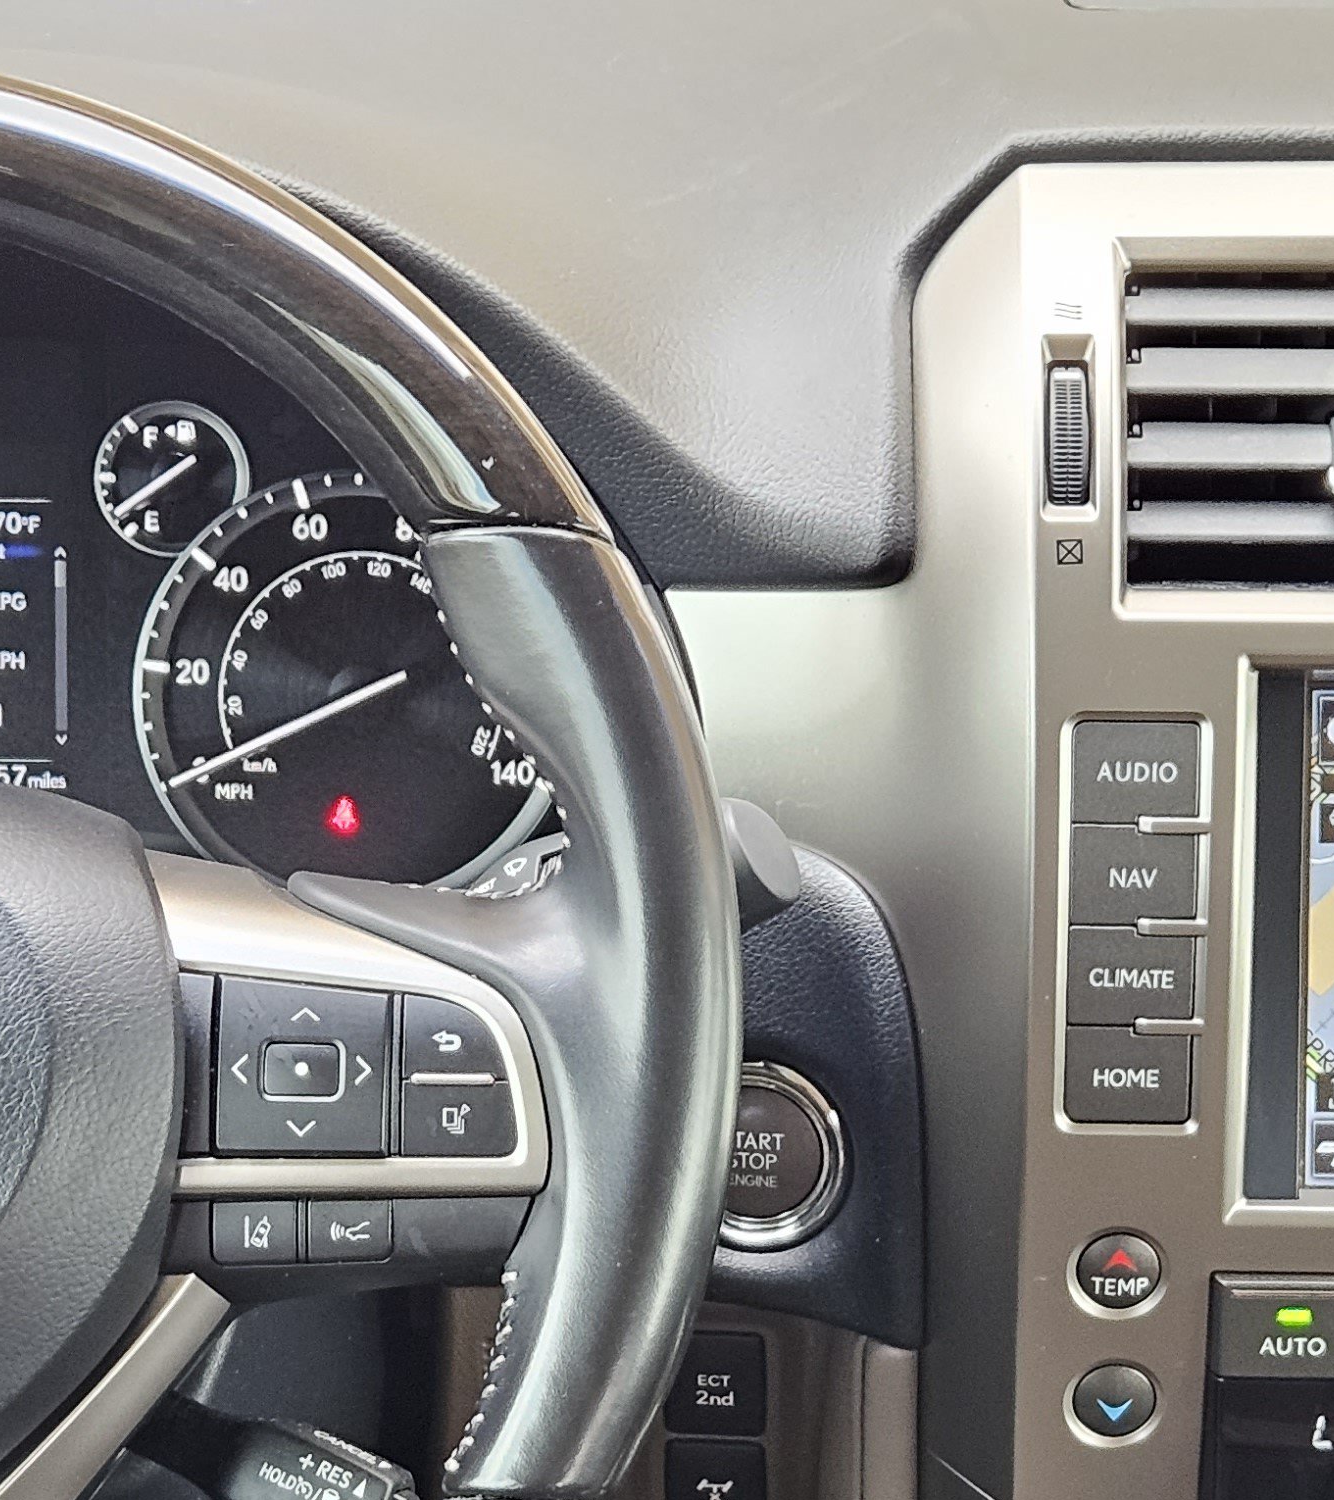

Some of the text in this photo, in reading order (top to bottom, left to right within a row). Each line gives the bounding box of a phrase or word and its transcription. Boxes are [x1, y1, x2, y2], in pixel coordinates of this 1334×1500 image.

[142, 427, 160, 449] F
[144, 513, 161, 533] E
[291, 514, 329, 542] 60
[212, 566, 250, 594] 40
[320, 561, 347, 580] 100
[366, 560, 392, 579] 120
[281, 578, 303, 599] 80
[250, 608, 269, 631] 60
[175, 658, 210, 686] 20
[231, 649, 249, 673] 40
[227, 694, 244, 717] 20
[490, 759, 537, 787] 140
[1096, 762, 1179, 784] AUDIO
[214, 782, 254, 801] MPH
[1108, 867, 1159, 889] NAV
[1089, 968, 1175, 990] CLIMATE
[1093, 1067, 1160, 1089] HOME
[1091, 1276, 1151, 1297] TEMP
[1259, 1336, 1327, 1357] AUTO
[697, 1374, 731, 1388] ECT
[696, 1390, 735, 1407] 2nd
[315, 1459, 353, 1489] RES
